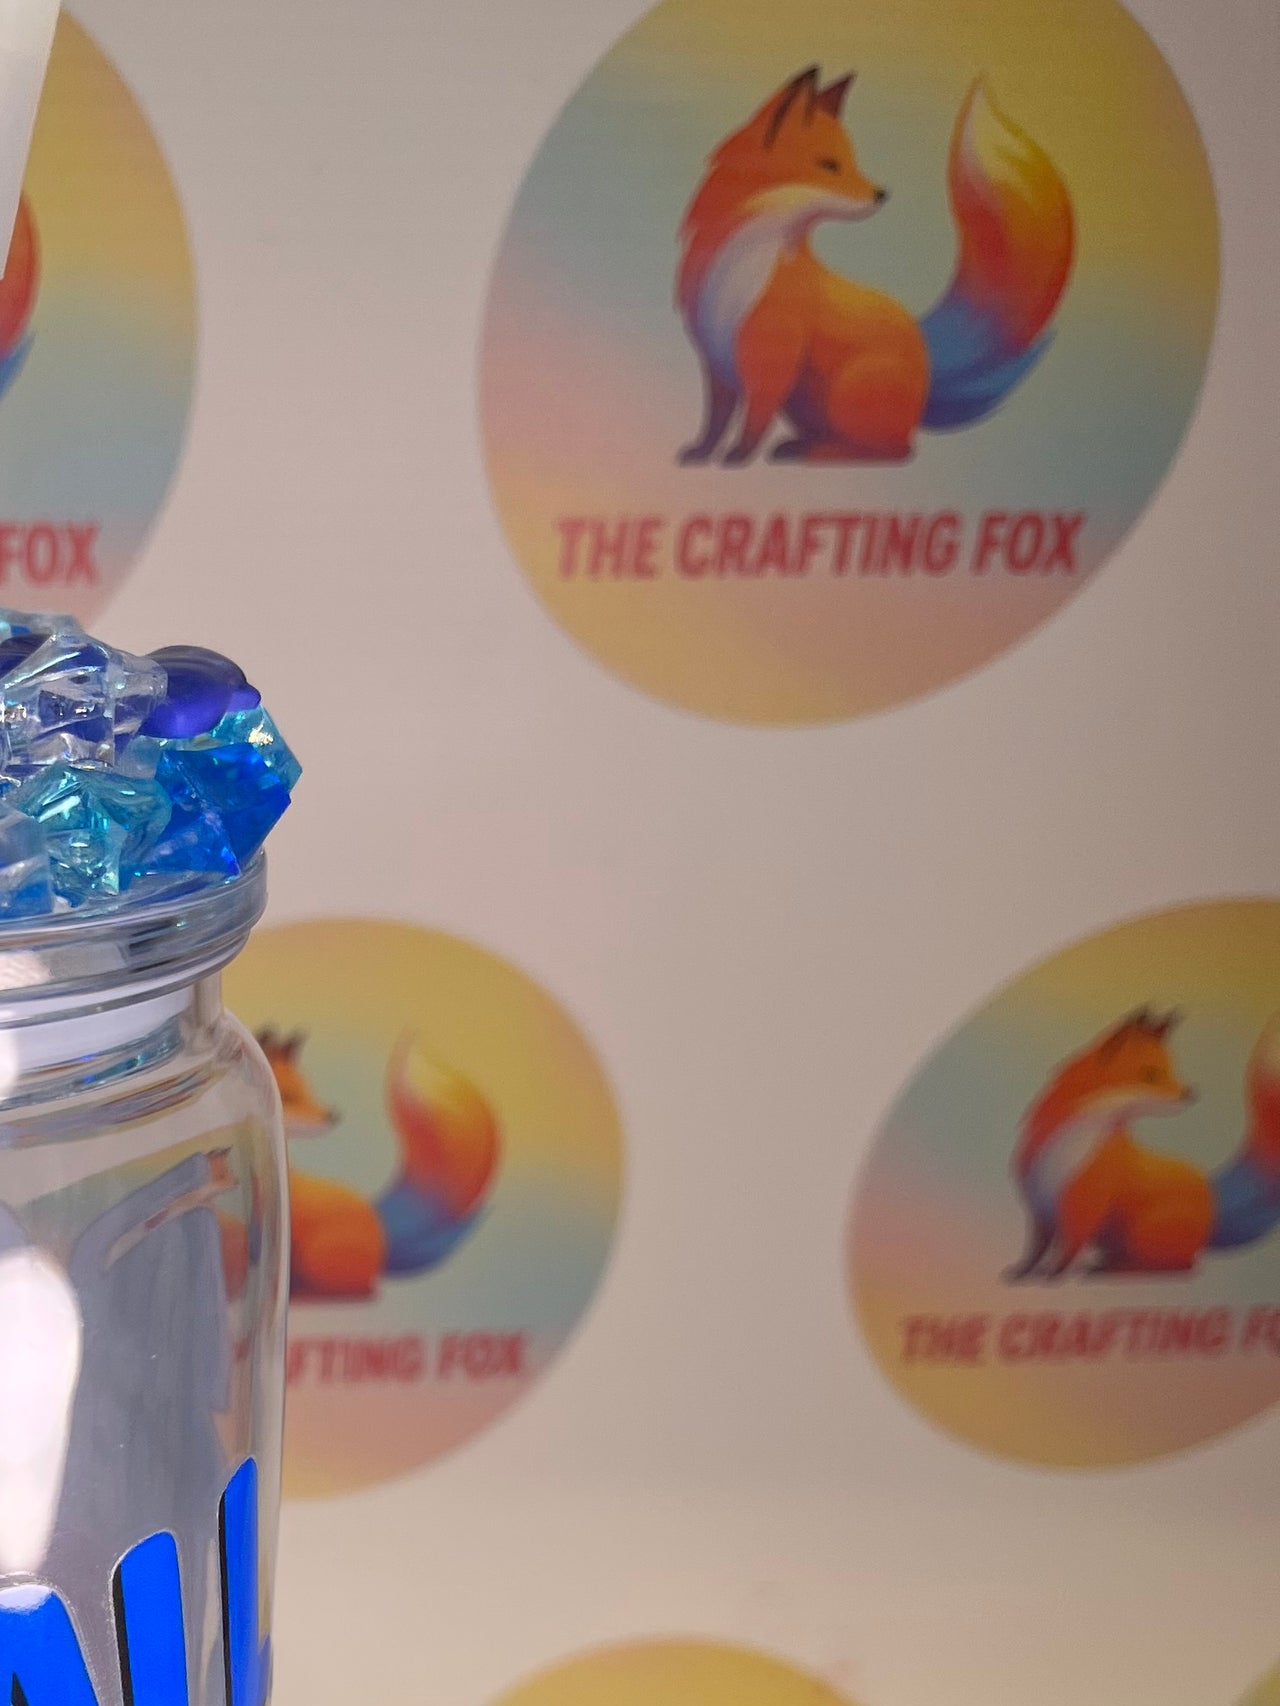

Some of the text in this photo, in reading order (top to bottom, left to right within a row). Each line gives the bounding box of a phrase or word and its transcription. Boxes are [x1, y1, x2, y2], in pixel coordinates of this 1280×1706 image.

[552, 510, 1085, 581] THE CRAFTING FOX
